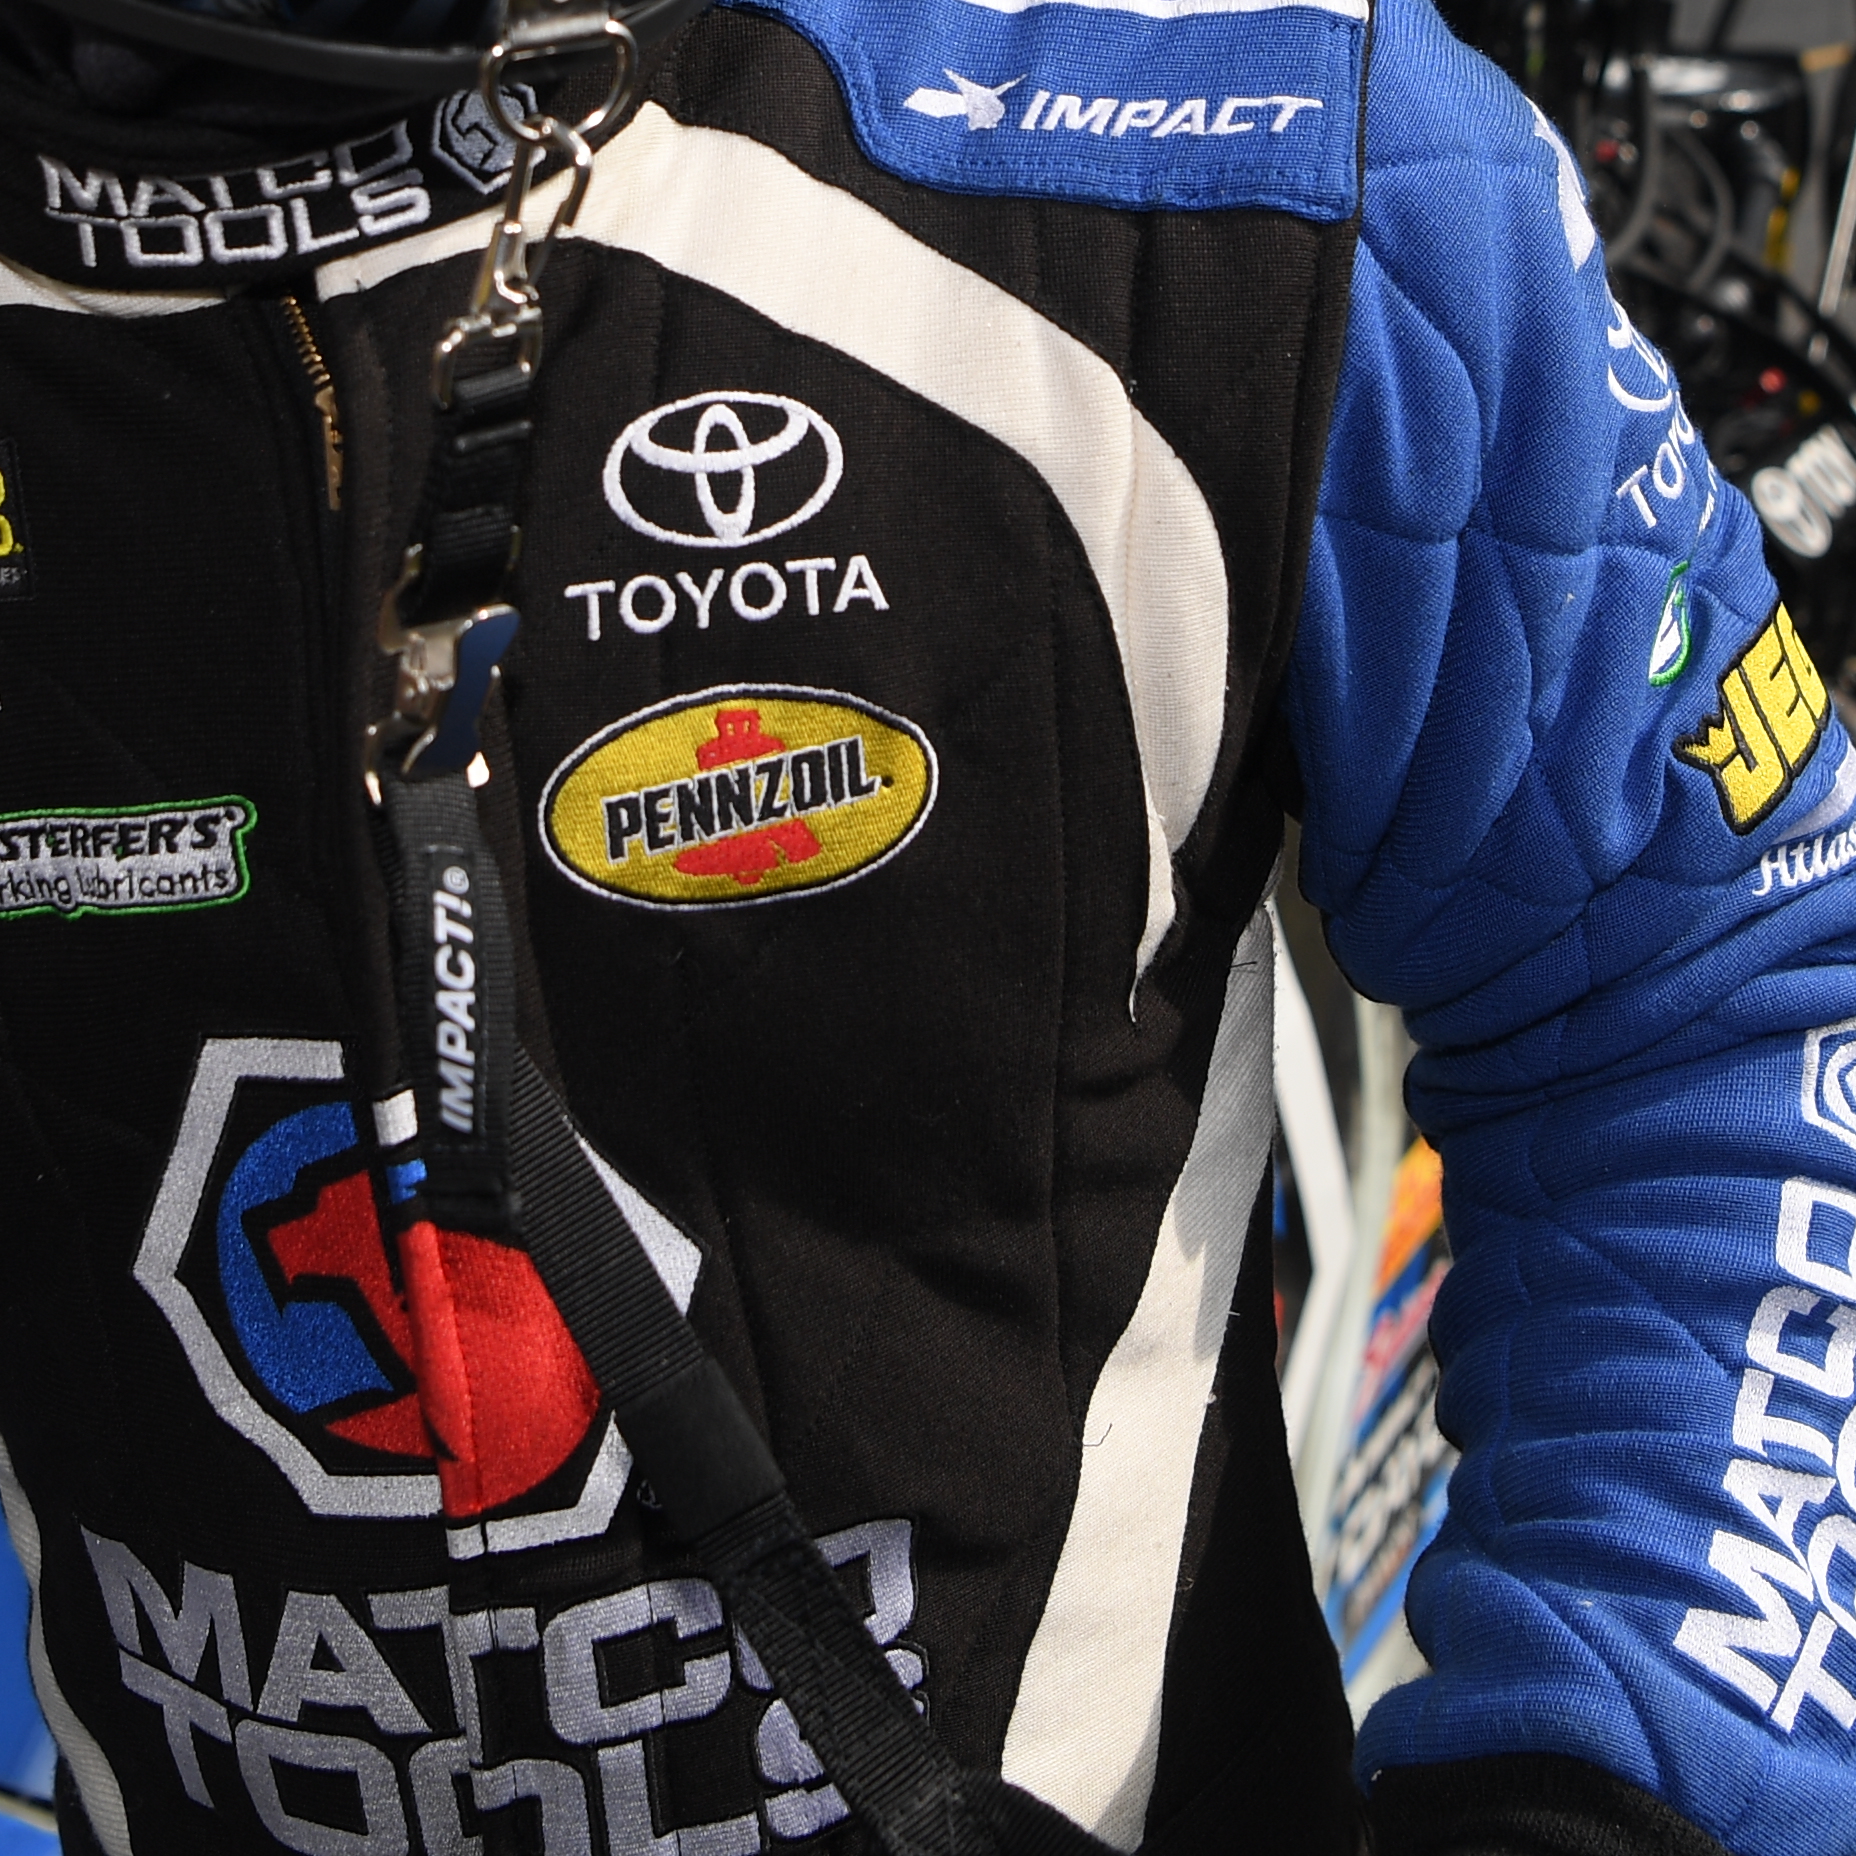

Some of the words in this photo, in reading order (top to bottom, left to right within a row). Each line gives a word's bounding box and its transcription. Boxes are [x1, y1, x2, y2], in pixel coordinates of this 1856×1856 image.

[1019, 90, 1324, 139] IMPACT
[45, 168, 431, 268] TOOLS
[563, 554, 890, 641] TOYOTA
[600, 734, 883, 865] PENNZOIL
